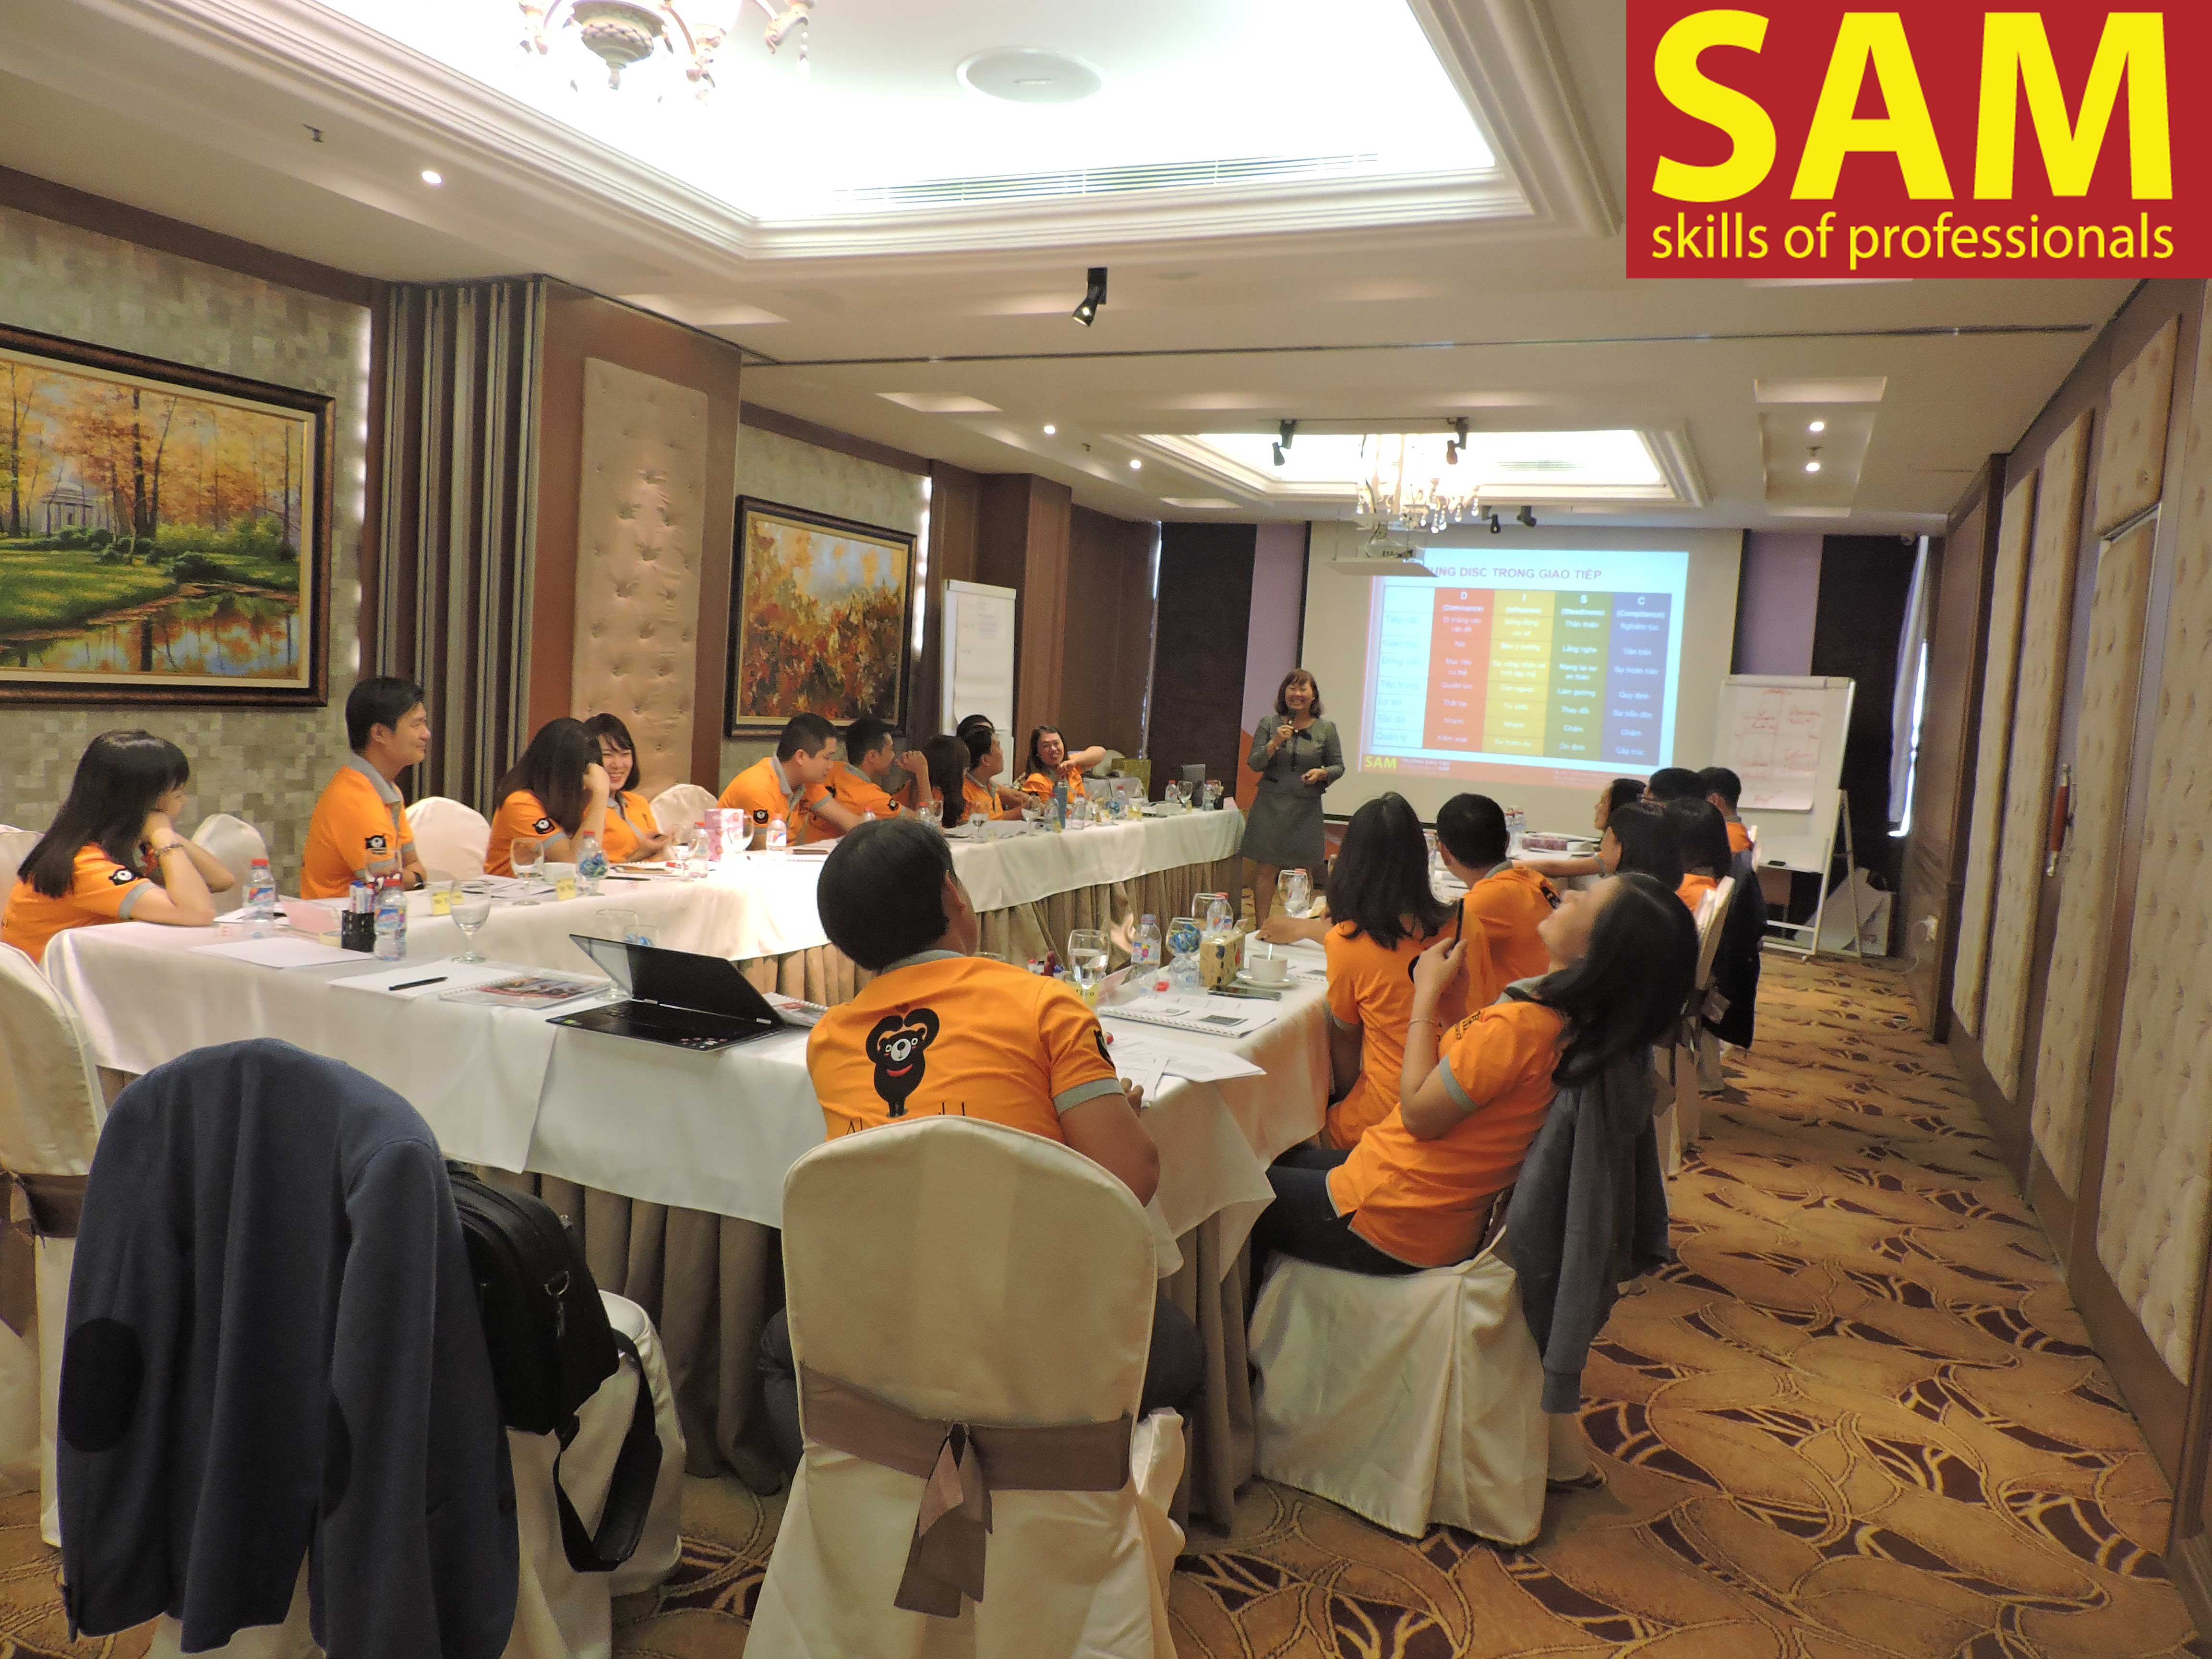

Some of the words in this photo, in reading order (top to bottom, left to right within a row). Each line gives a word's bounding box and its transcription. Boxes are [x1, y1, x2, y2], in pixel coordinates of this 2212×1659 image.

[1460, 567, 1487, 577] DISC
[1492, 568, 1535, 578] TRONG
[1539, 568, 1570, 579] GIAO
[1365, 755, 1397, 769] SAM
